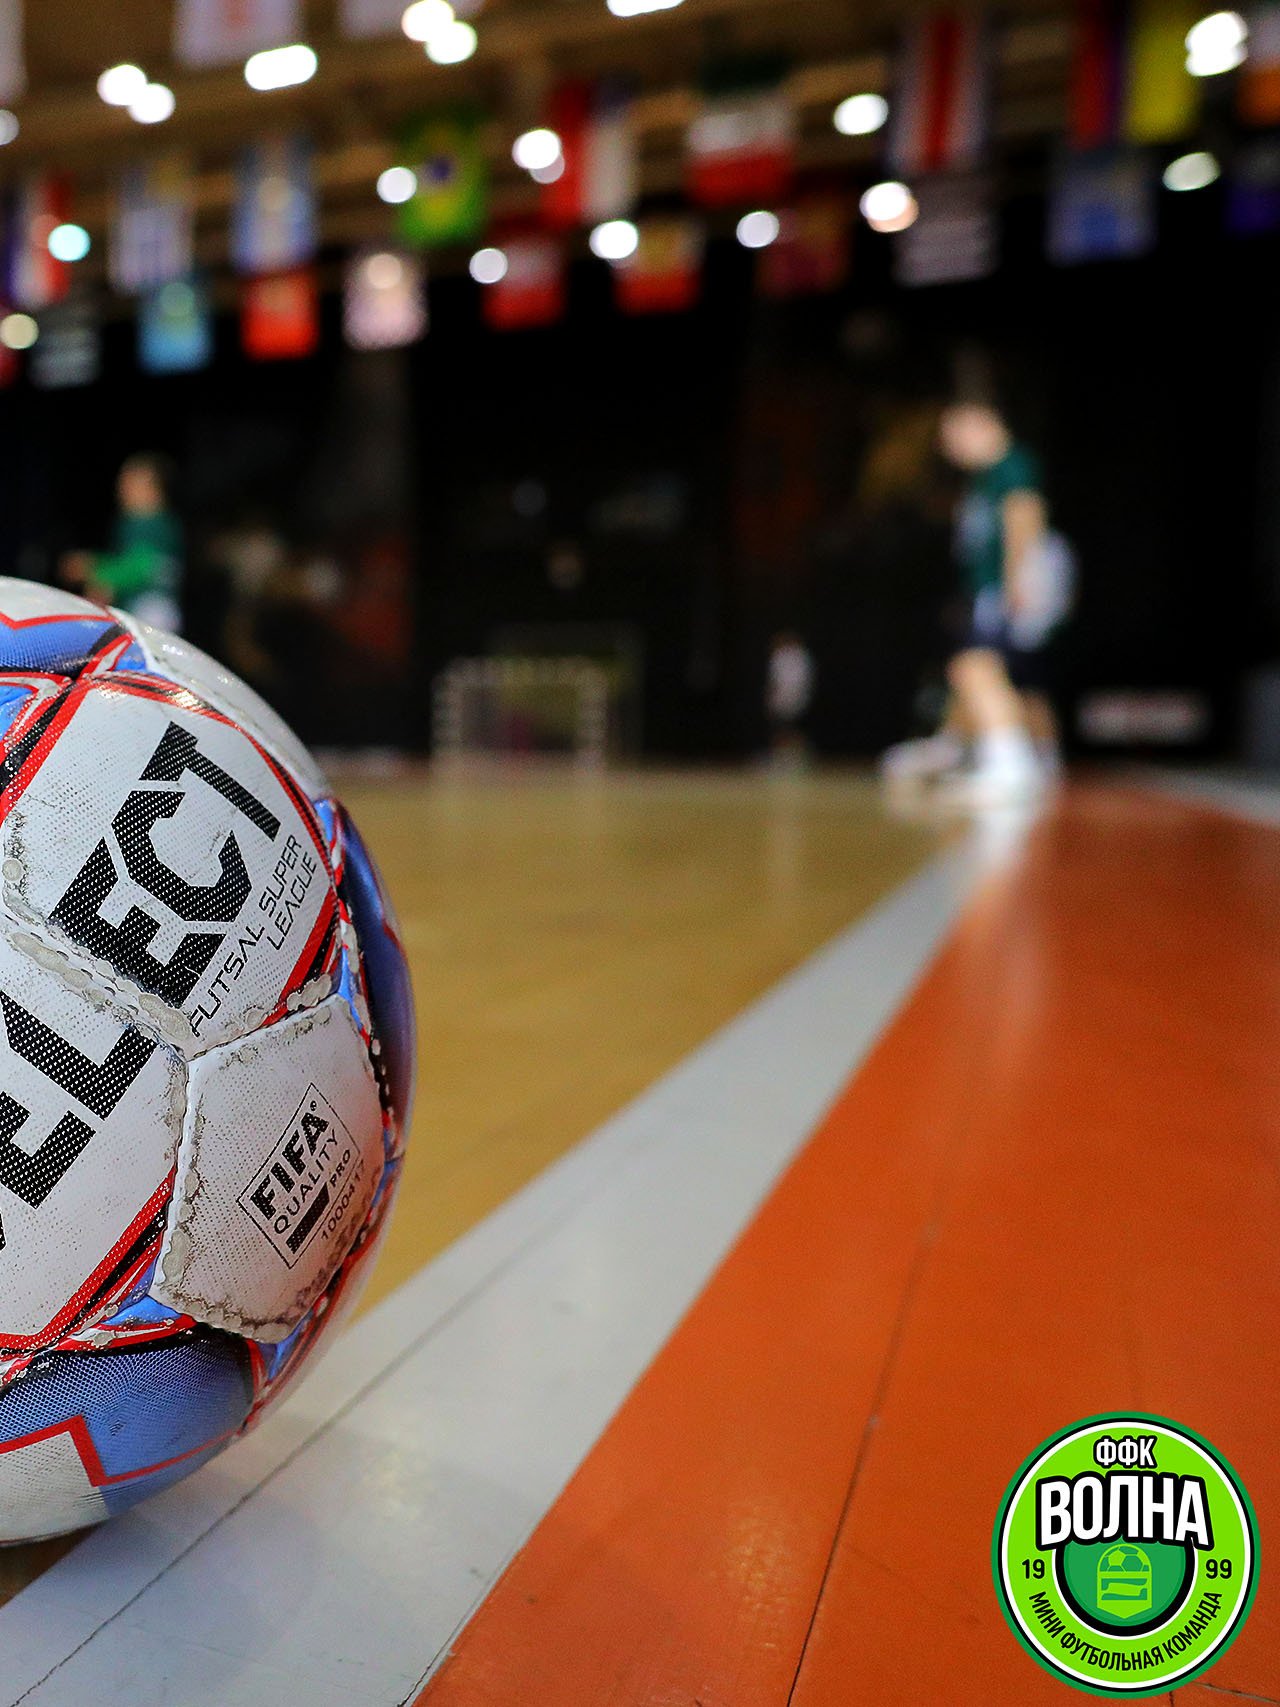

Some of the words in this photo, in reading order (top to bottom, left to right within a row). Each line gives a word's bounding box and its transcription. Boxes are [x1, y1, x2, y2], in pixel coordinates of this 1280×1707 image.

[190, 926, 265, 1037] FUTSAL
[258, 834, 302, 917] SUPER
[266, 851, 317, 951] LEAGUE
[273, 1128, 338, 1235] QUALITY
[329, 1149, 351, 1188] PRO
